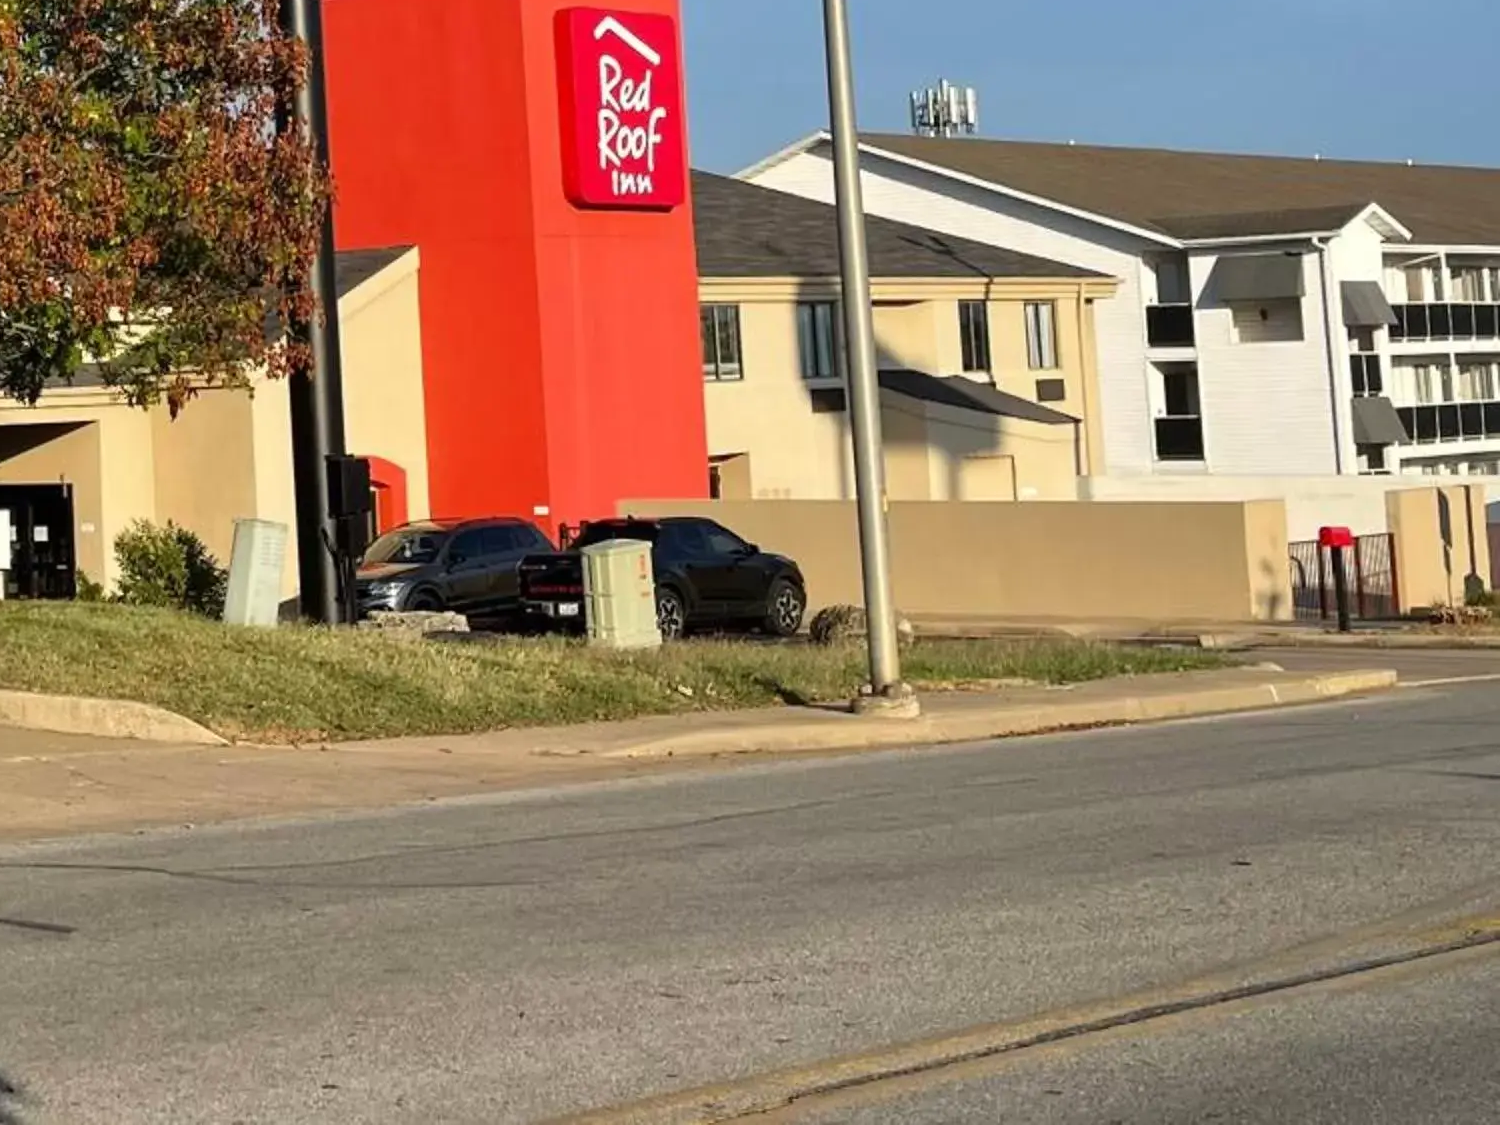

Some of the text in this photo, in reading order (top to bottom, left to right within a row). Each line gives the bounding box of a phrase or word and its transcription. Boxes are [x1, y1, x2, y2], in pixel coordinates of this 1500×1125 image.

[599, 54, 652, 113] Red
[597, 106, 667, 172] Roof
[611, 169, 653, 195] Inn
